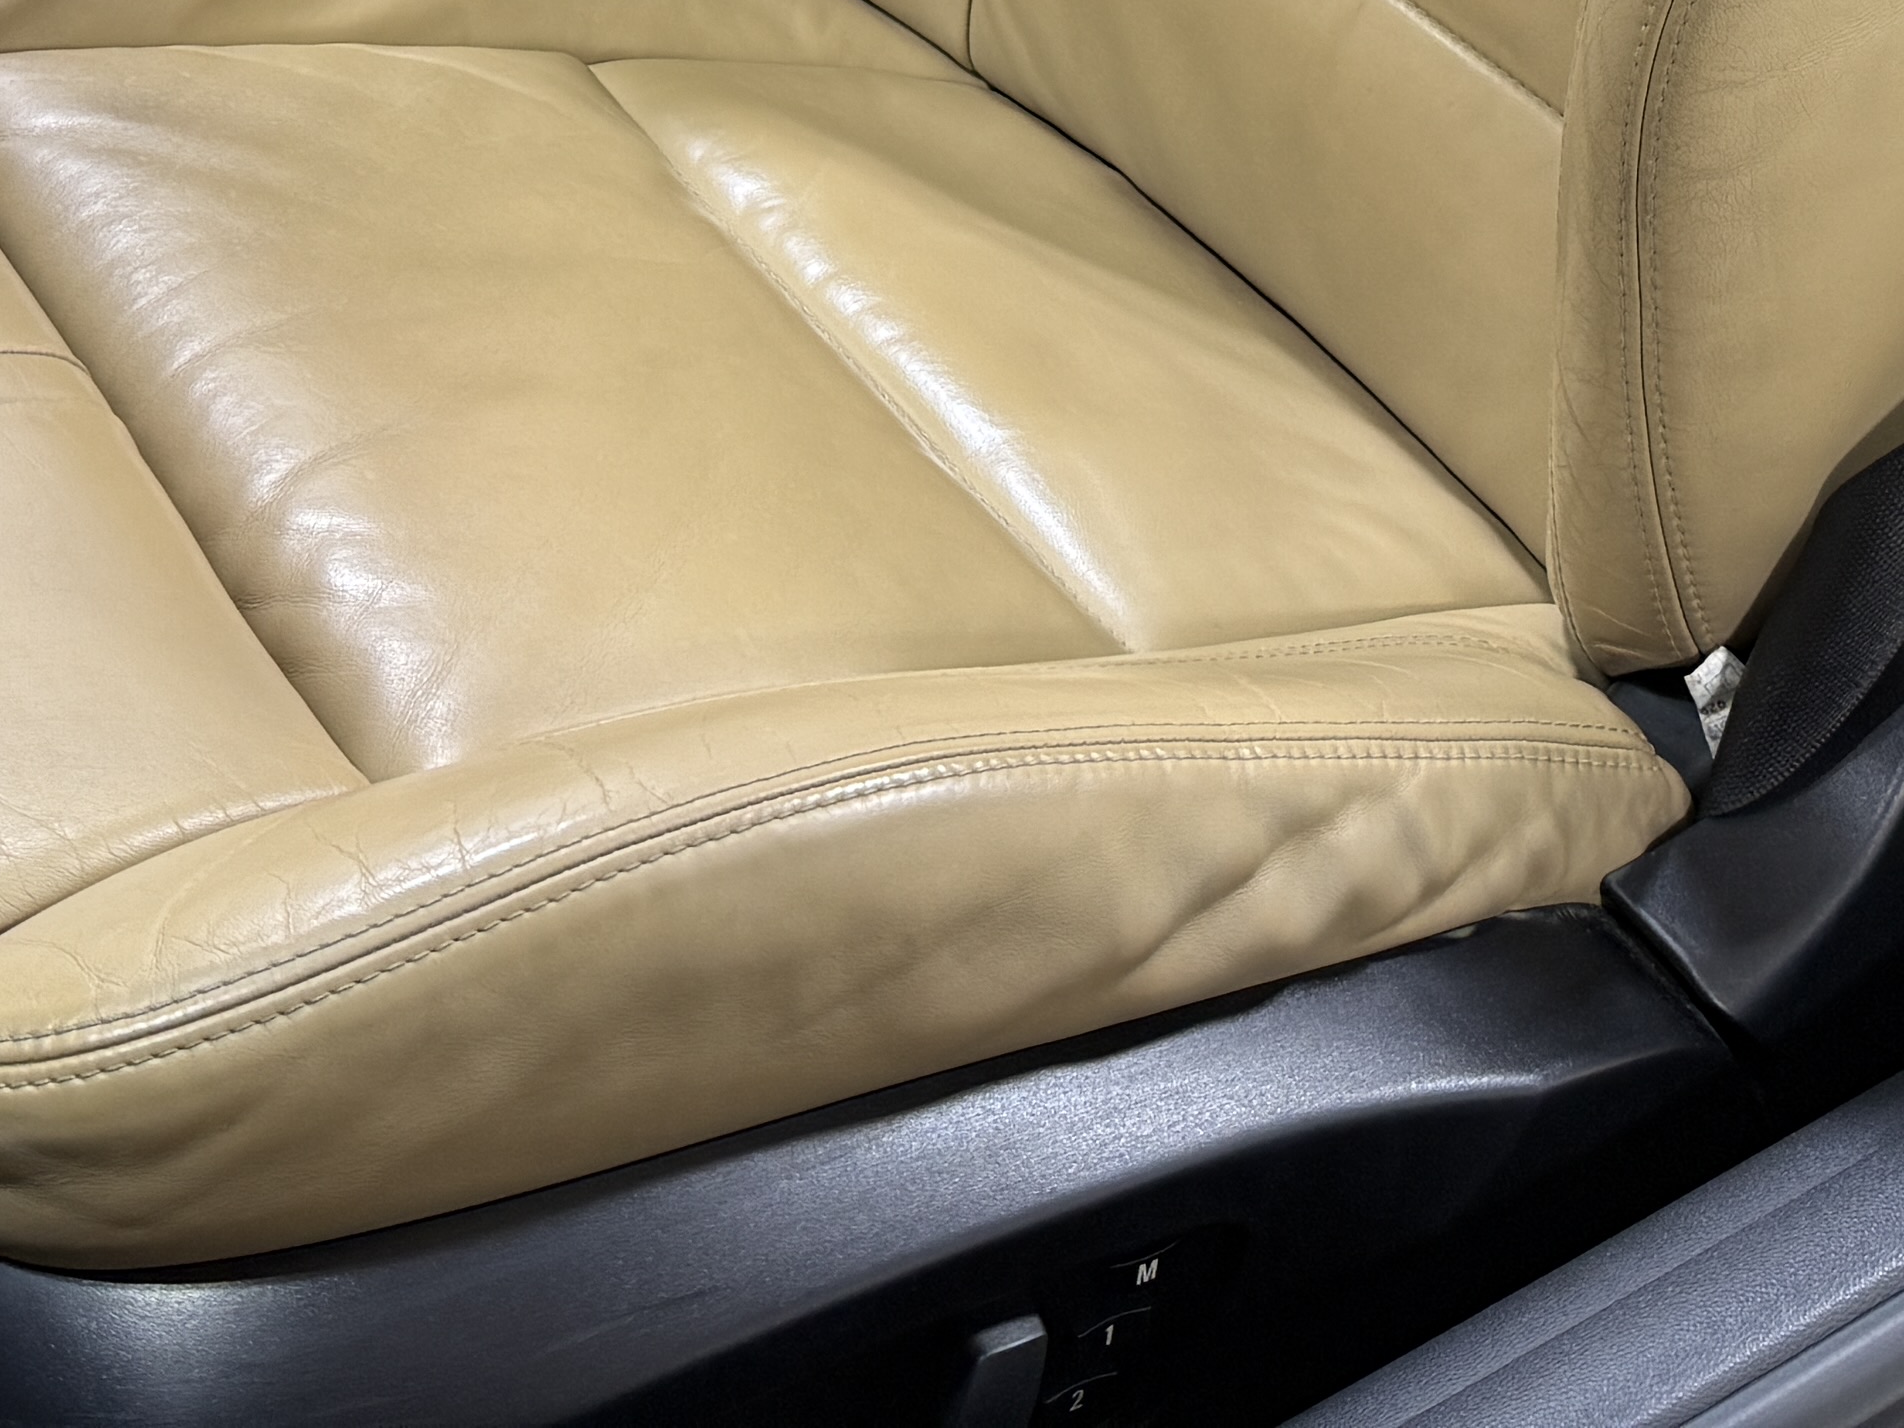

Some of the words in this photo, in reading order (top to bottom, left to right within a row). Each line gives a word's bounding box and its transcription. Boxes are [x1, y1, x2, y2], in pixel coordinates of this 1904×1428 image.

[1136, 1258, 1159, 1286] M
[1105, 1324, 1114, 1346] 1
[1069, 1389, 1084, 1412] 2
